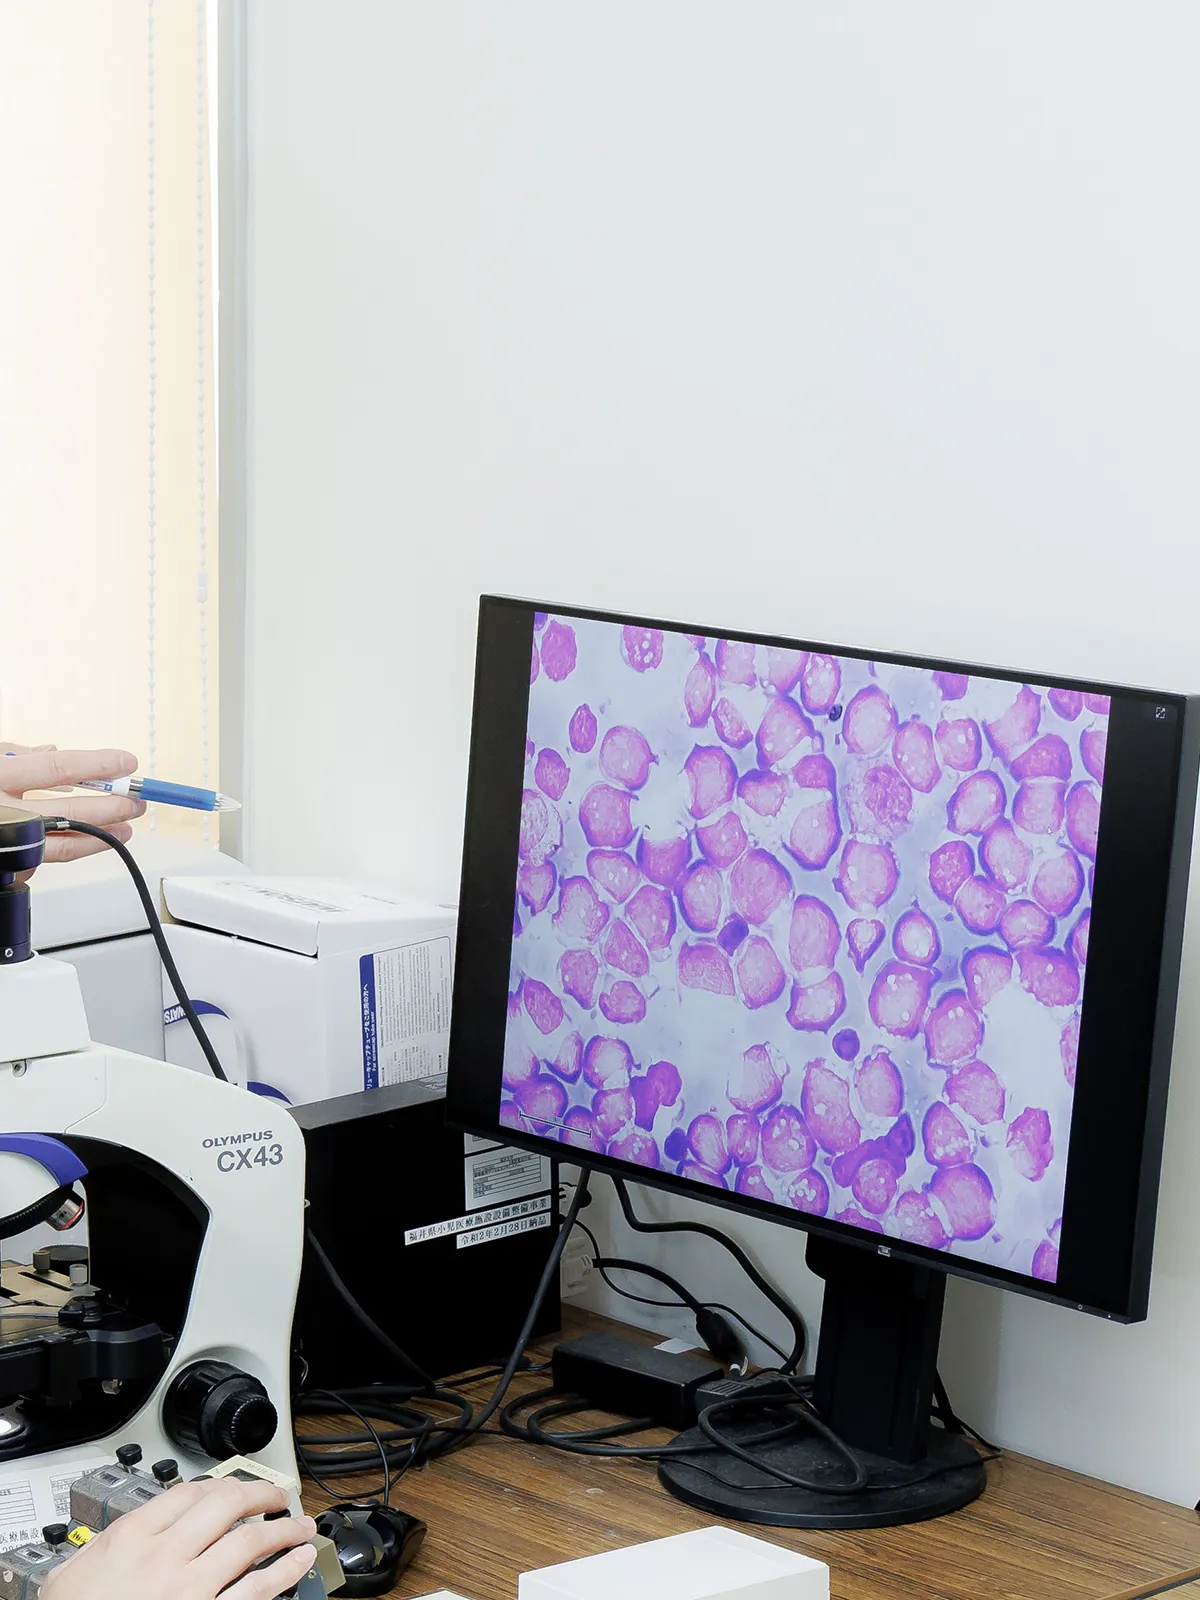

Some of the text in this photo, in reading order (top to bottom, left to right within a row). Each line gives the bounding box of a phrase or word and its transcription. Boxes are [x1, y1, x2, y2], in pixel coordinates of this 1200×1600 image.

[164, 1006, 187, 1023] WATS
[363, 983, 374, 1090] リューキャップチューブをご使用の方へ
[202, 1130, 273, 1149] OLYMPUS
[217, 1143, 284, 1172] CX43
[409, 1198, 548, 1242] 福井県小児医療施設設備整備事業
[460, 1215, 548, 1245] 令和2年2月28日納品
